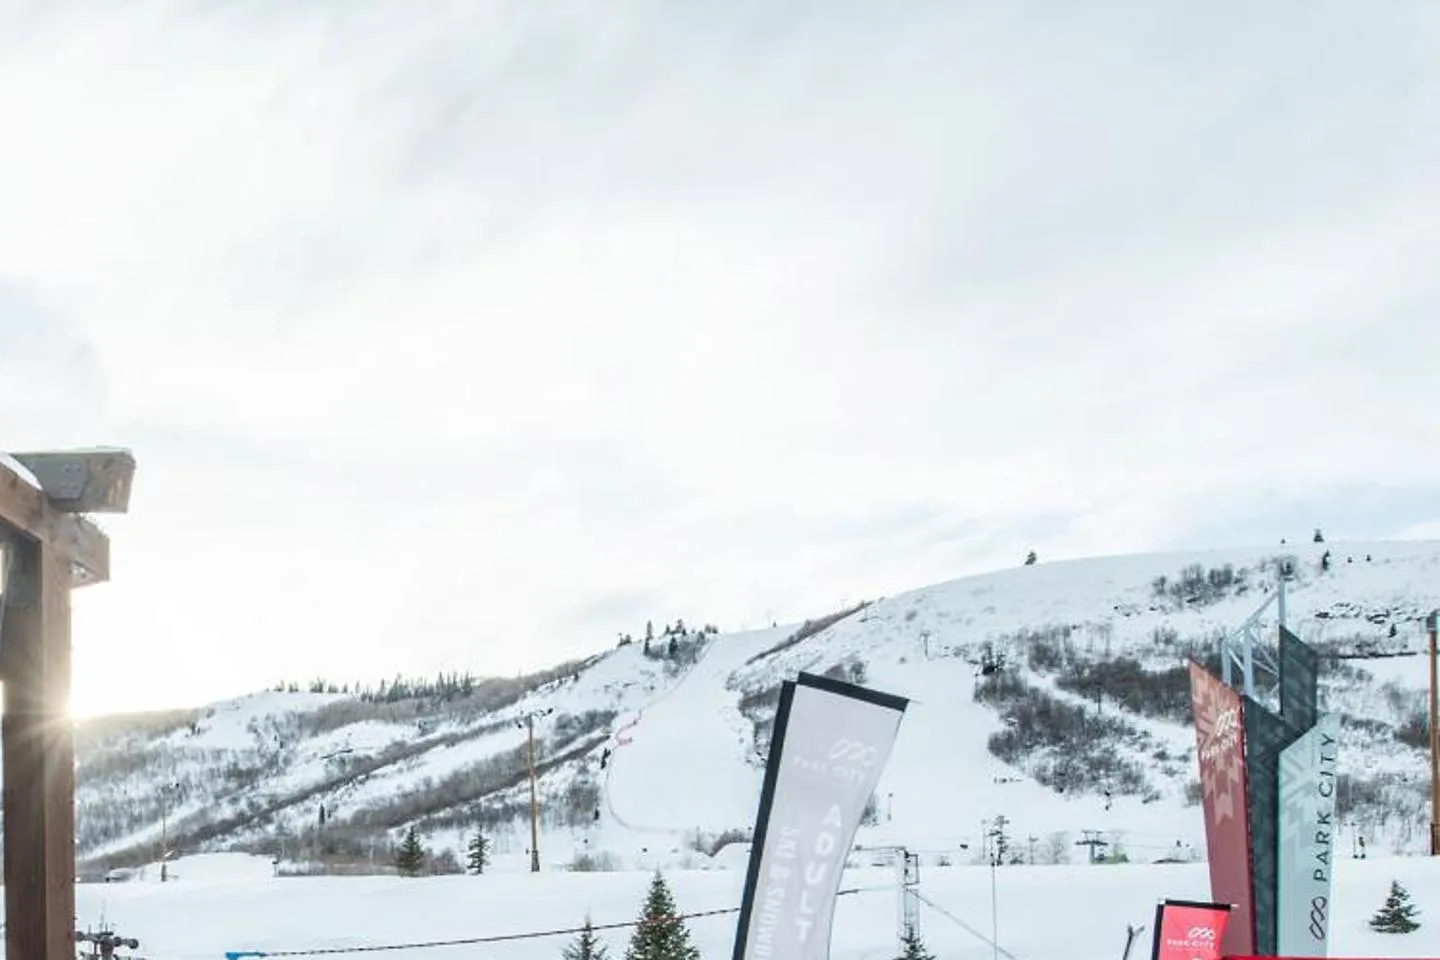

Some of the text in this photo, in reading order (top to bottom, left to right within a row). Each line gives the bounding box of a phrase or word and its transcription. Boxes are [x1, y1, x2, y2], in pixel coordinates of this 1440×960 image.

[796, 803, 842, 943] ADULT
[1313, 733, 1335, 882] PARK CITY
